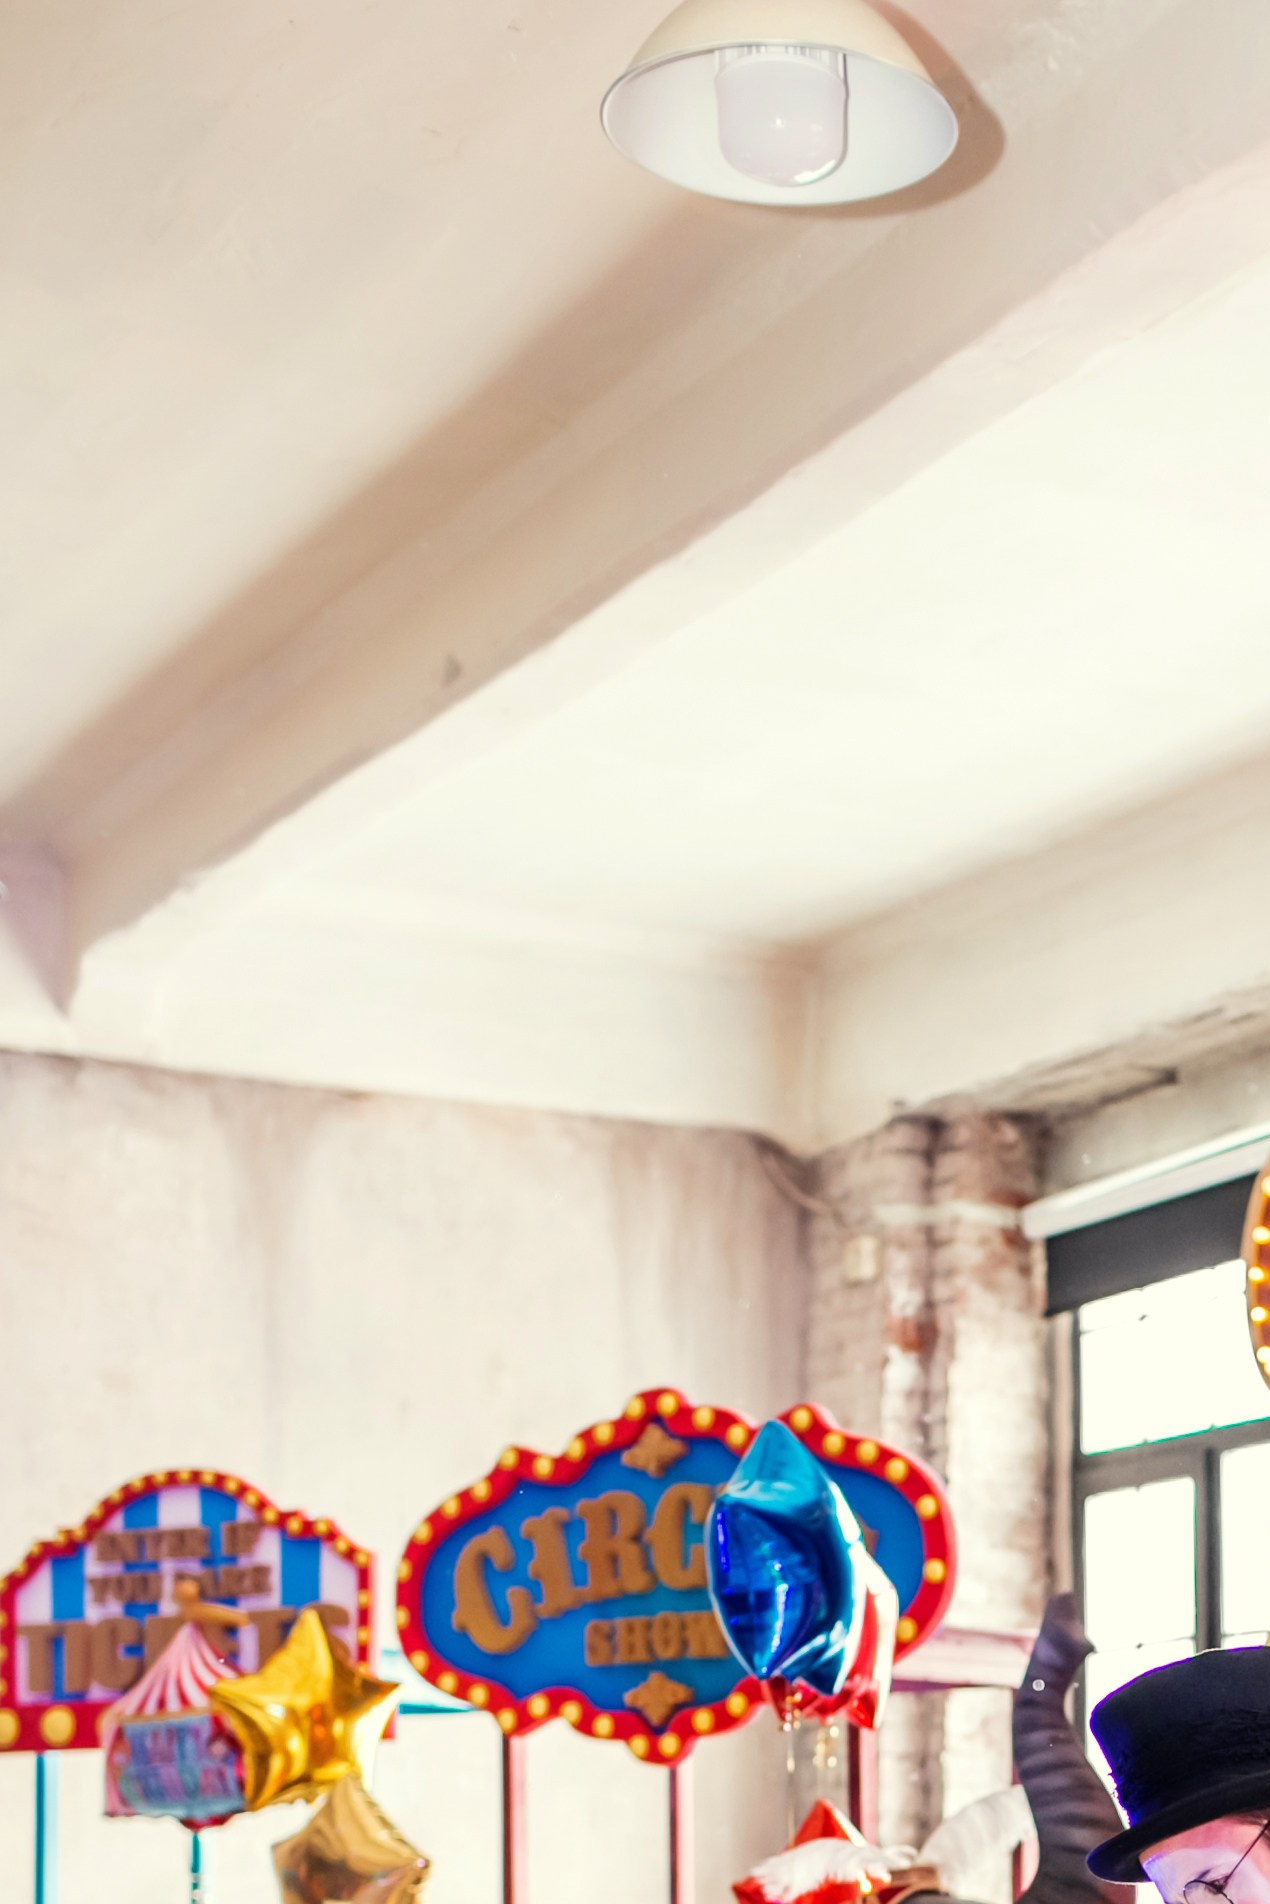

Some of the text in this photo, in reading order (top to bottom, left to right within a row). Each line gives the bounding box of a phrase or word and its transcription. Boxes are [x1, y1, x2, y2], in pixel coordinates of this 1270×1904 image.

[220, 1521, 262, 1555] IF
[452, 1482, 879, 1655] CIRC
[88, 1572, 163, 1604] YOU
